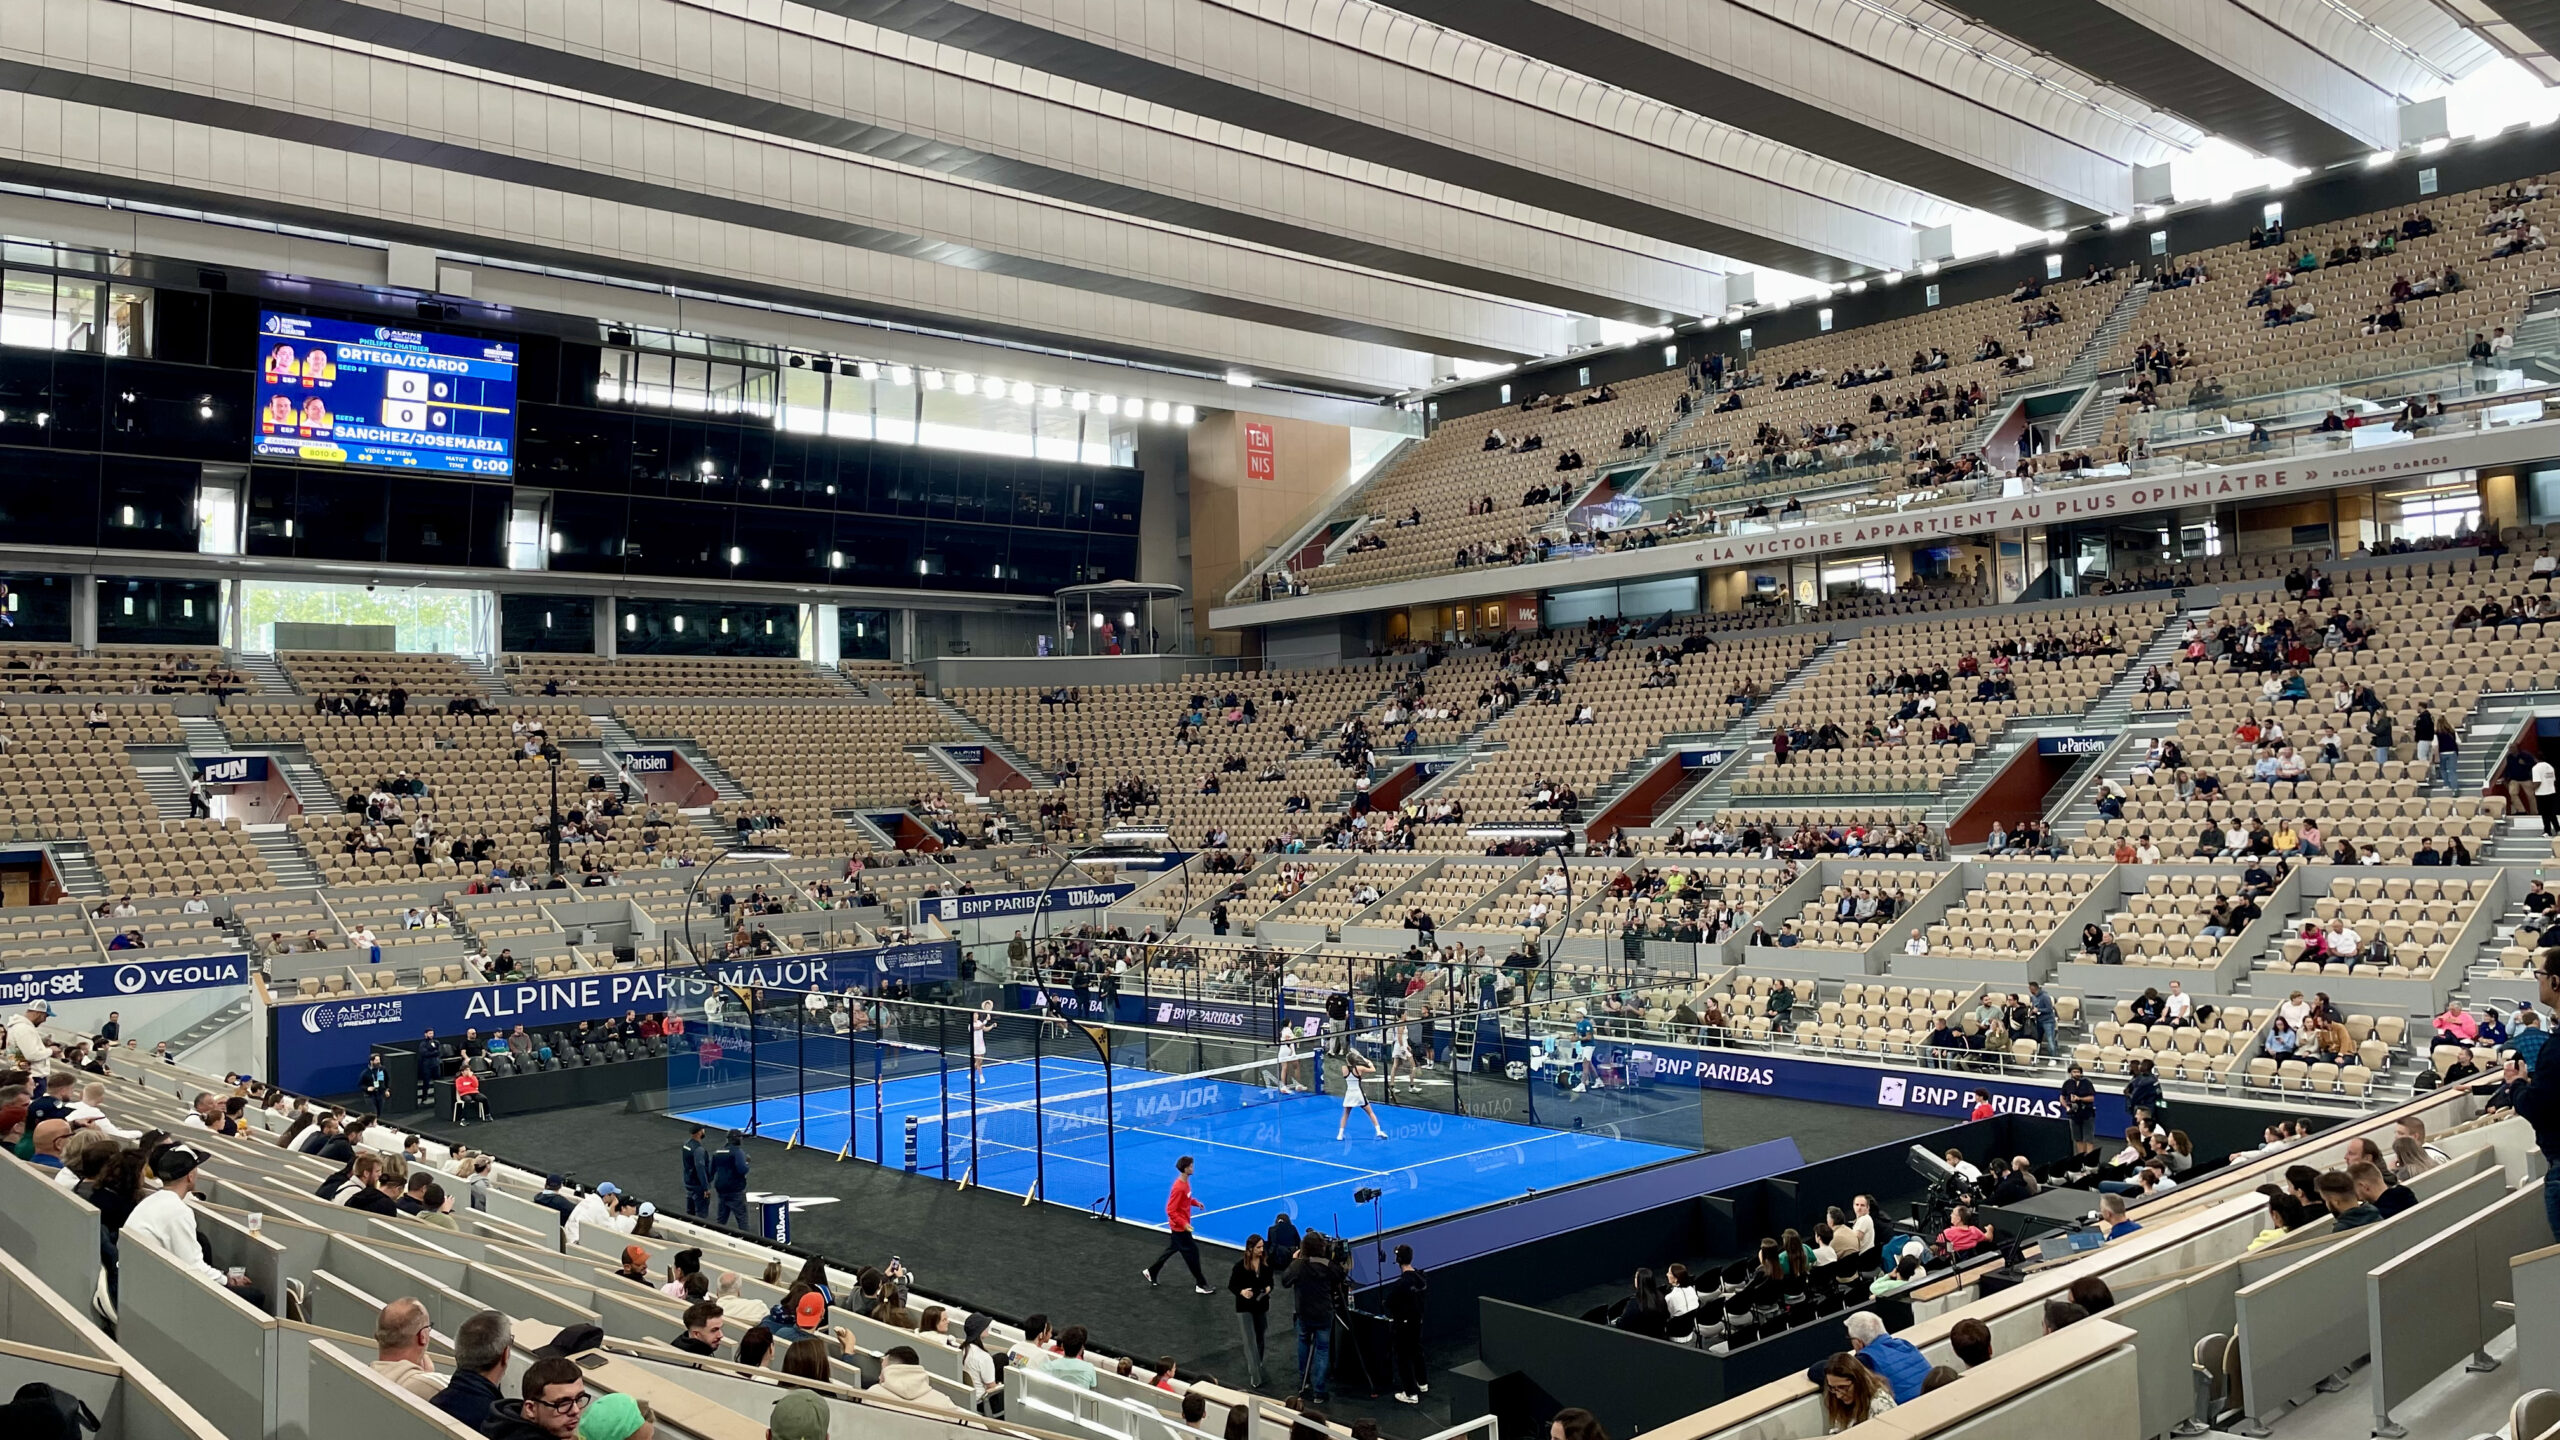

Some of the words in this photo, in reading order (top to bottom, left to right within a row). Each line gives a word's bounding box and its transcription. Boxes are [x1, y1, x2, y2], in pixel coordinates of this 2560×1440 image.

[359, 338, 392, 348] PHILIPPE
[394, 342, 429, 353] CHATRIER
[338, 364, 357, 372] SEED
[339, 347, 469, 373] ORTEGA/ICARDO
[402, 380, 415, 394] 0
[434, 382, 448, 398] 0
[335, 414, 354, 422] SEED
[401, 409, 413, 423] 0
[432, 411, 447, 427] 0
[335, 426, 503, 452] SANCHEZ/JOSEMARIA
[1249, 430, 1269, 447] TEN
[268, 446, 295, 454] VEOLIA
[364, 447, 385, 455] VIDEO
[387, 449, 412, 457] REVIEW
[472, 458, 508, 472] 0:00
[1252, 456, 1270, 473] NIS
[2333, 462, 2386, 477] ROLAND
[1714, 546, 1734, 561] LA
[1745, 530, 1843, 556] VICTOIRE
[1855, 510, 1998, 542] APPARTIENT
[2011, 504, 2041, 521] AU
[2056, 494, 2115, 515] PLUS
[2131, 471, 2287, 505] OPINIÂTRE
[2057, 741, 2067, 753] Le
[2067, 737, 2105, 752] Parisien
[626, 753, 667, 770] Parisien
[1702, 751, 1721, 766] FUN
[205, 758, 247, 782] FUN
[962, 900, 992, 914] BNP
[995, 895, 1052, 911] PARIBAS
[1067, 889, 1116, 906] Wilson
[150, 964, 238, 985] VEOLIA
[465, 980, 600, 1020] ALPINE
[612, 969, 706, 1004] PARIS
[719, 958, 828, 989] MAJOR
[337, 1011, 365, 1022] PARIS
[366, 1008, 402, 1019] MAJOR
[338, 1000, 402, 1014] ALPINE
[343, 1019, 376, 1027] PREMIER
[379, 1016, 402, 1024] PADEL
[1173, 1007, 1196, 1021] BNP
[1199, 1010, 1244, 1026] PARIBAS
[1655, 1057, 1692, 1076] BNP
[1695, 1061, 1774, 1086] PARIBAS
[1136, 1084, 1219, 1118] MAJOR
[1911, 1085, 1958, 1106] BNP
[775, 1206, 786, 1244] Wilson
